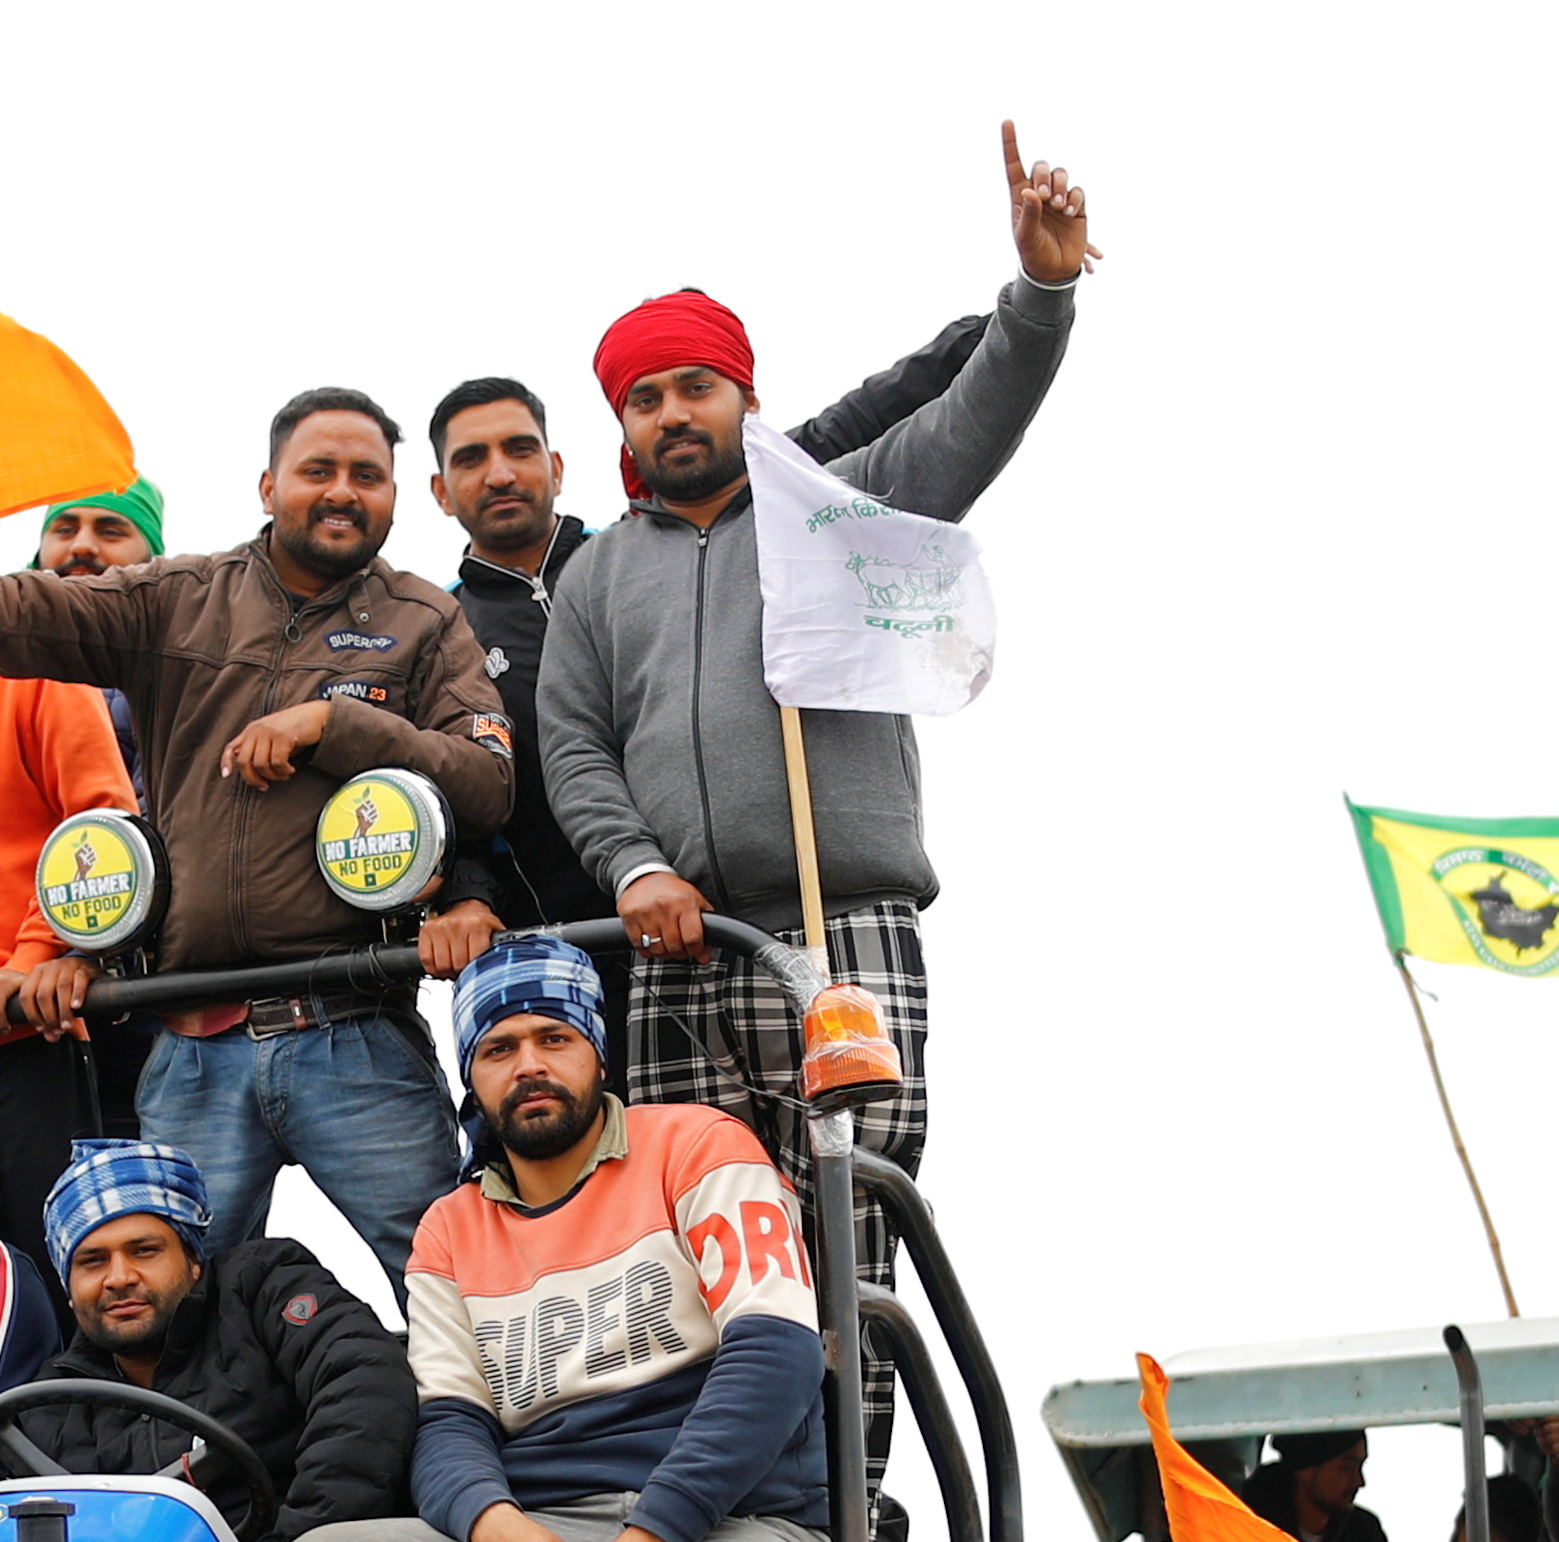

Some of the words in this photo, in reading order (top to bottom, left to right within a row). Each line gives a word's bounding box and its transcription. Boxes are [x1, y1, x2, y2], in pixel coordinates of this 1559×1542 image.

[325, 841, 346, 861] NO
[349, 831, 412, 858] FARMER
[339, 861, 358, 876] NO
[363, 854, 402, 873] FOOD
[47, 885, 67, 906] NO
[70, 873, 130, 901] FARMER
[62, 903, 80, 920] NO
[84, 896, 121, 915] FOOD
[475, 1260, 688, 1414] SUPER
